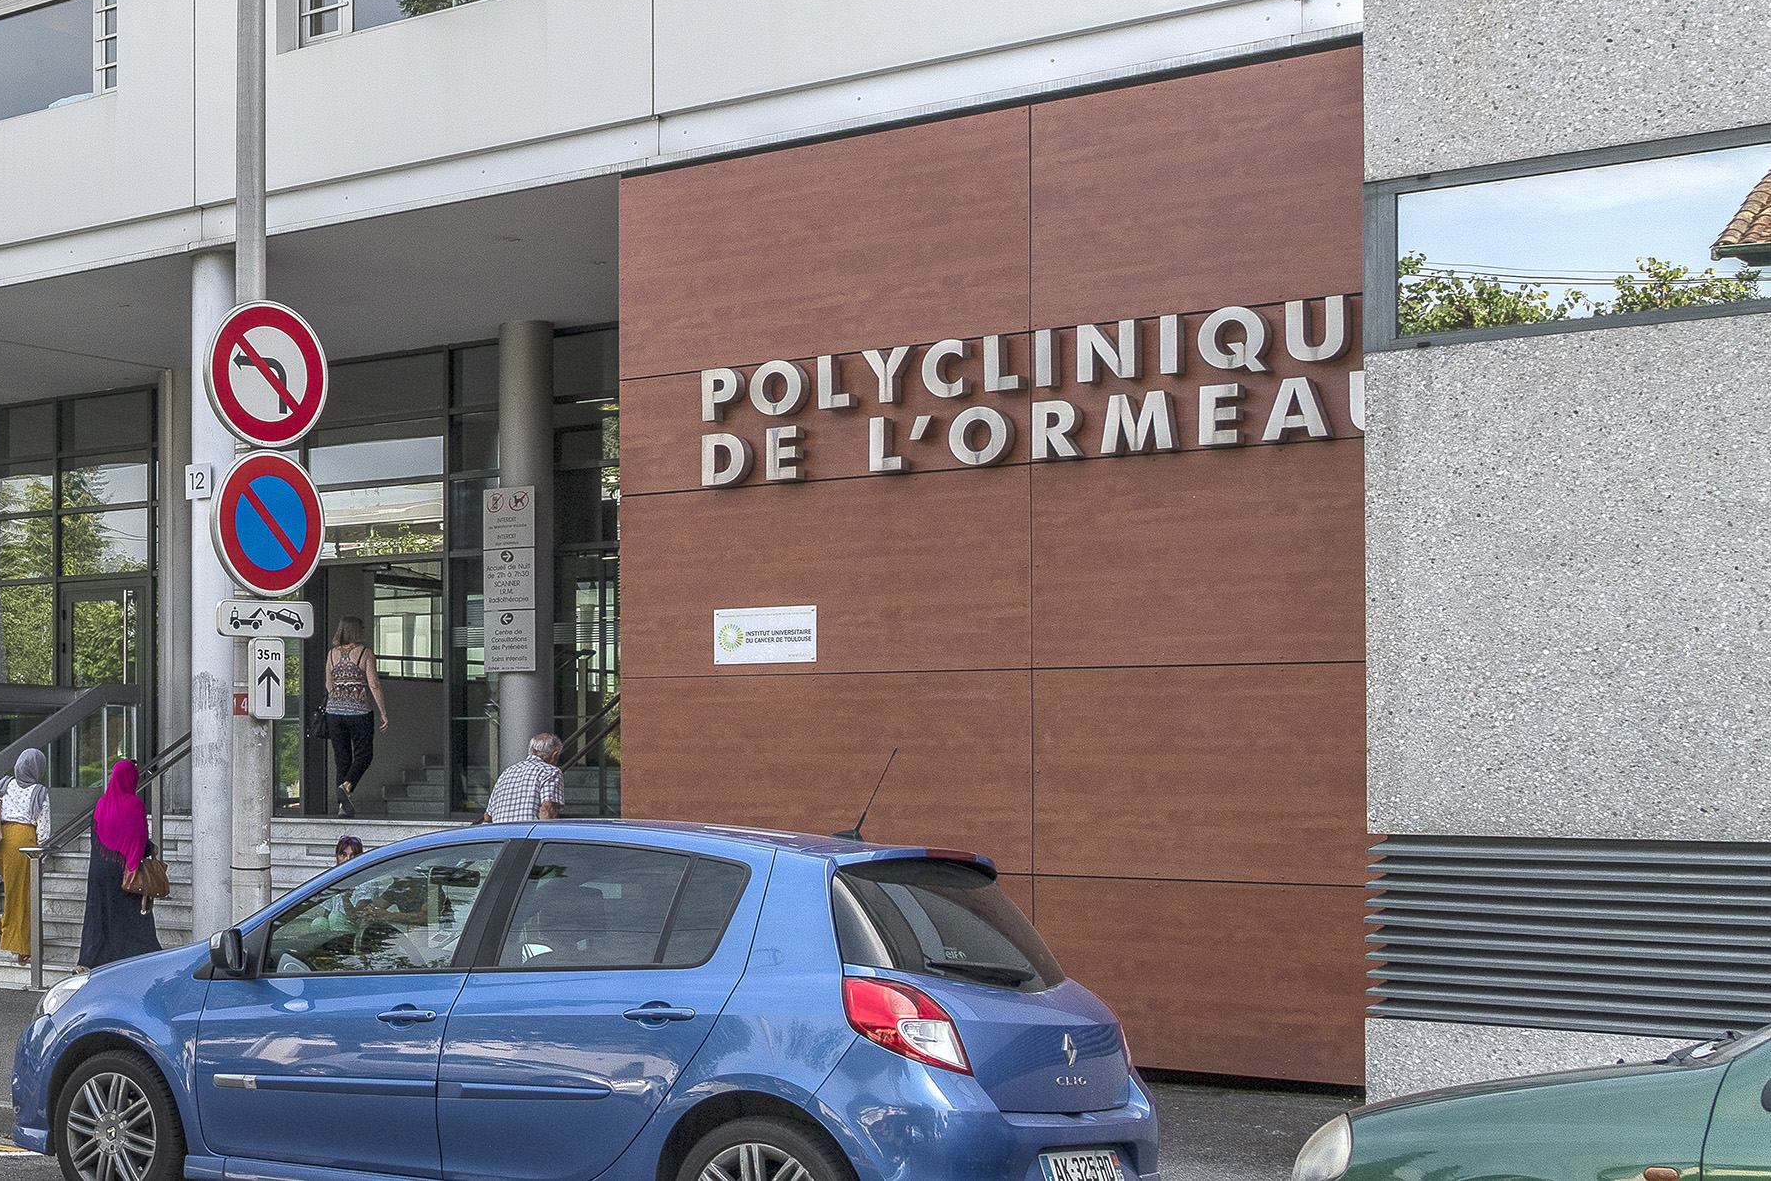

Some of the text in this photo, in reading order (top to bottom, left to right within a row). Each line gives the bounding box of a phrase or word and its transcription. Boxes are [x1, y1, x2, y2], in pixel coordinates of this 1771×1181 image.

[700, 370, 1365, 488] DE L'ORMEA
[189, 472, 205, 490] 12
[488, 595, 529, 603] Radiothérapie
